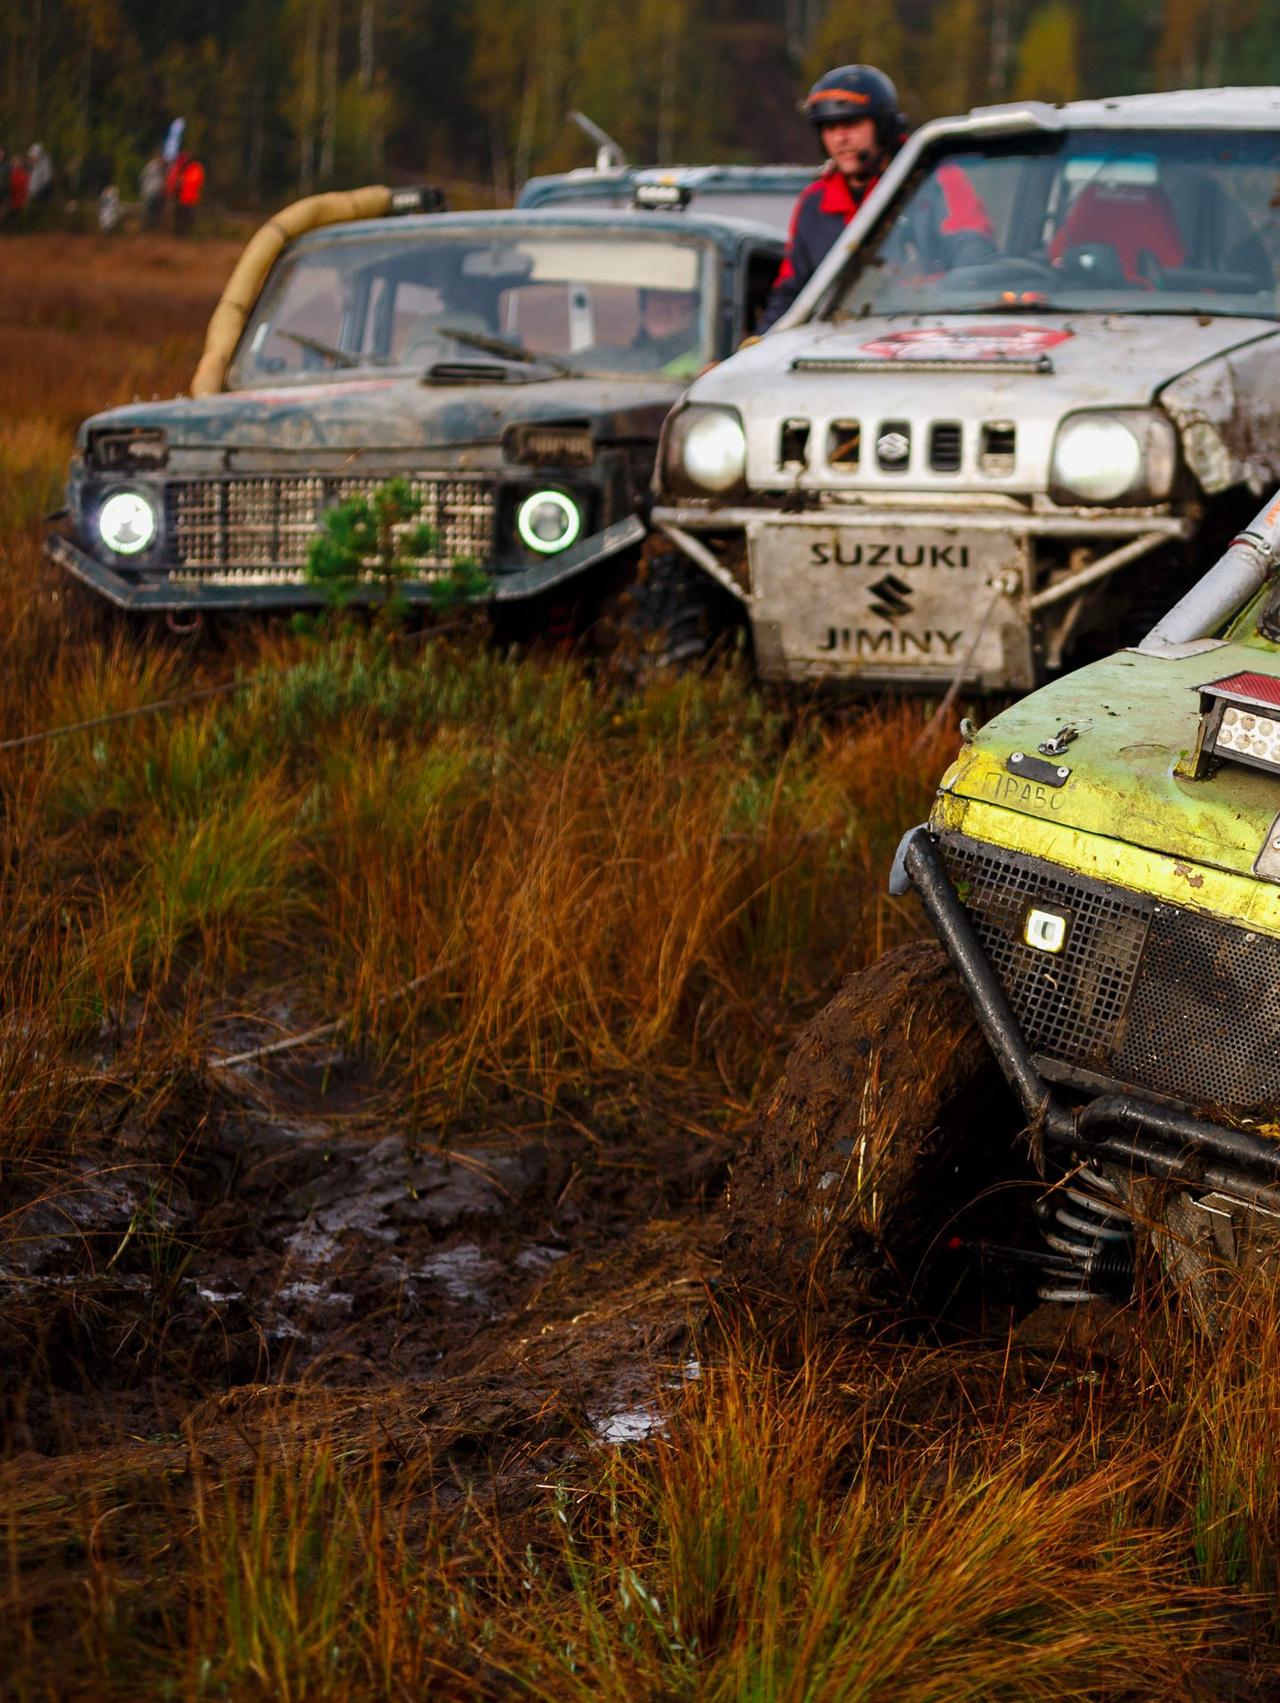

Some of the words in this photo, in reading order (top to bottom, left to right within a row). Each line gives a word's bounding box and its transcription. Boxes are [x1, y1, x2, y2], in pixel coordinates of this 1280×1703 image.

[809, 542, 969, 568] SUZUKI
[816, 626, 963, 655] JIMNY
[981, 772, 1066, 810] ПРАВО
